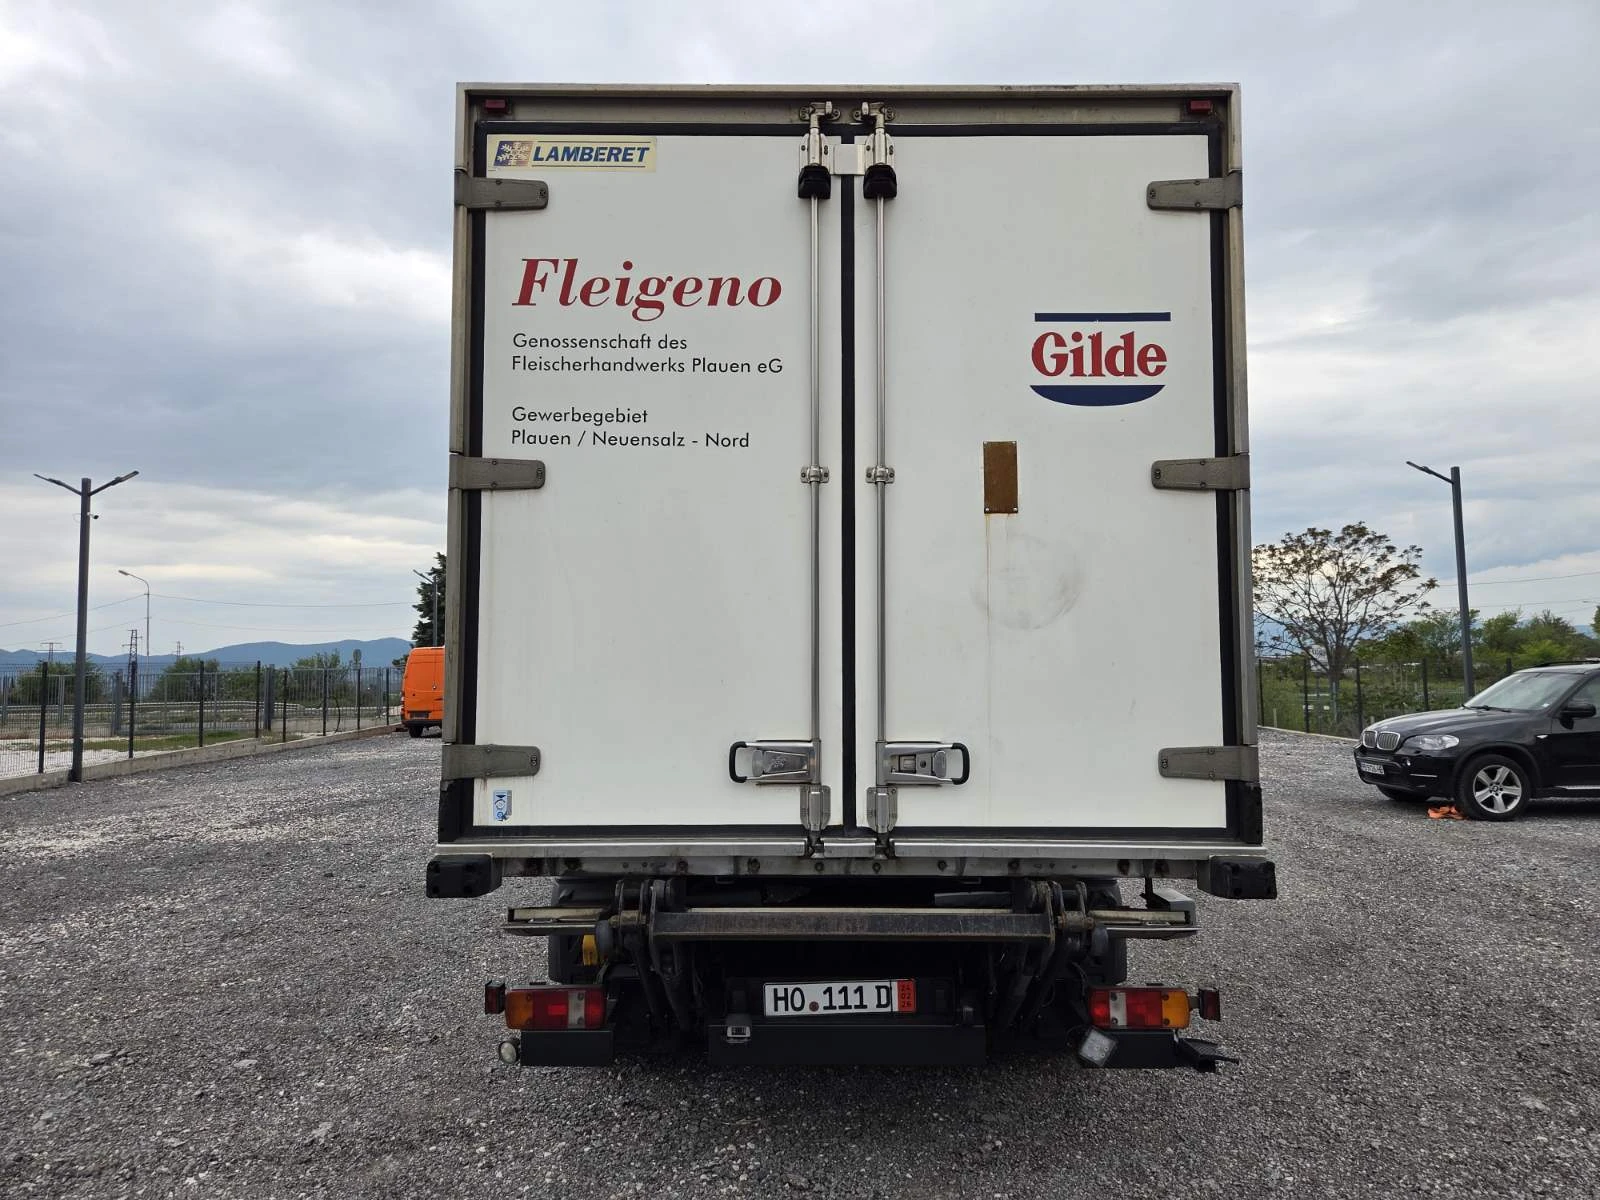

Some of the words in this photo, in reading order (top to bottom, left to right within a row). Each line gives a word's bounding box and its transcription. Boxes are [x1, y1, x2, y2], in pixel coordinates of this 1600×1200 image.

[532, 146, 650, 163] LAMBERET
[512, 258, 782, 322] Fleigeno
[513, 333, 651, 349] Genossenschaft
[657, 334, 688, 350] des
[1031, 331, 1168, 377] Gilde
[512, 355, 685, 373] Fleischerhandwerks
[692, 357, 751, 373] Plauen
[757, 358, 783, 374] eG
[512, 406, 648, 427] Gewerbegebiet
[512, 429, 571, 446] Plauen
[577, 430, 587, 448] /
[592, 431, 686, 447] Neuensalz
[705, 432, 750, 448] Nord
[773, 987, 806, 1012] HO
[822, 985, 868, 1011] 111
[875, 984, 891, 1009] D
